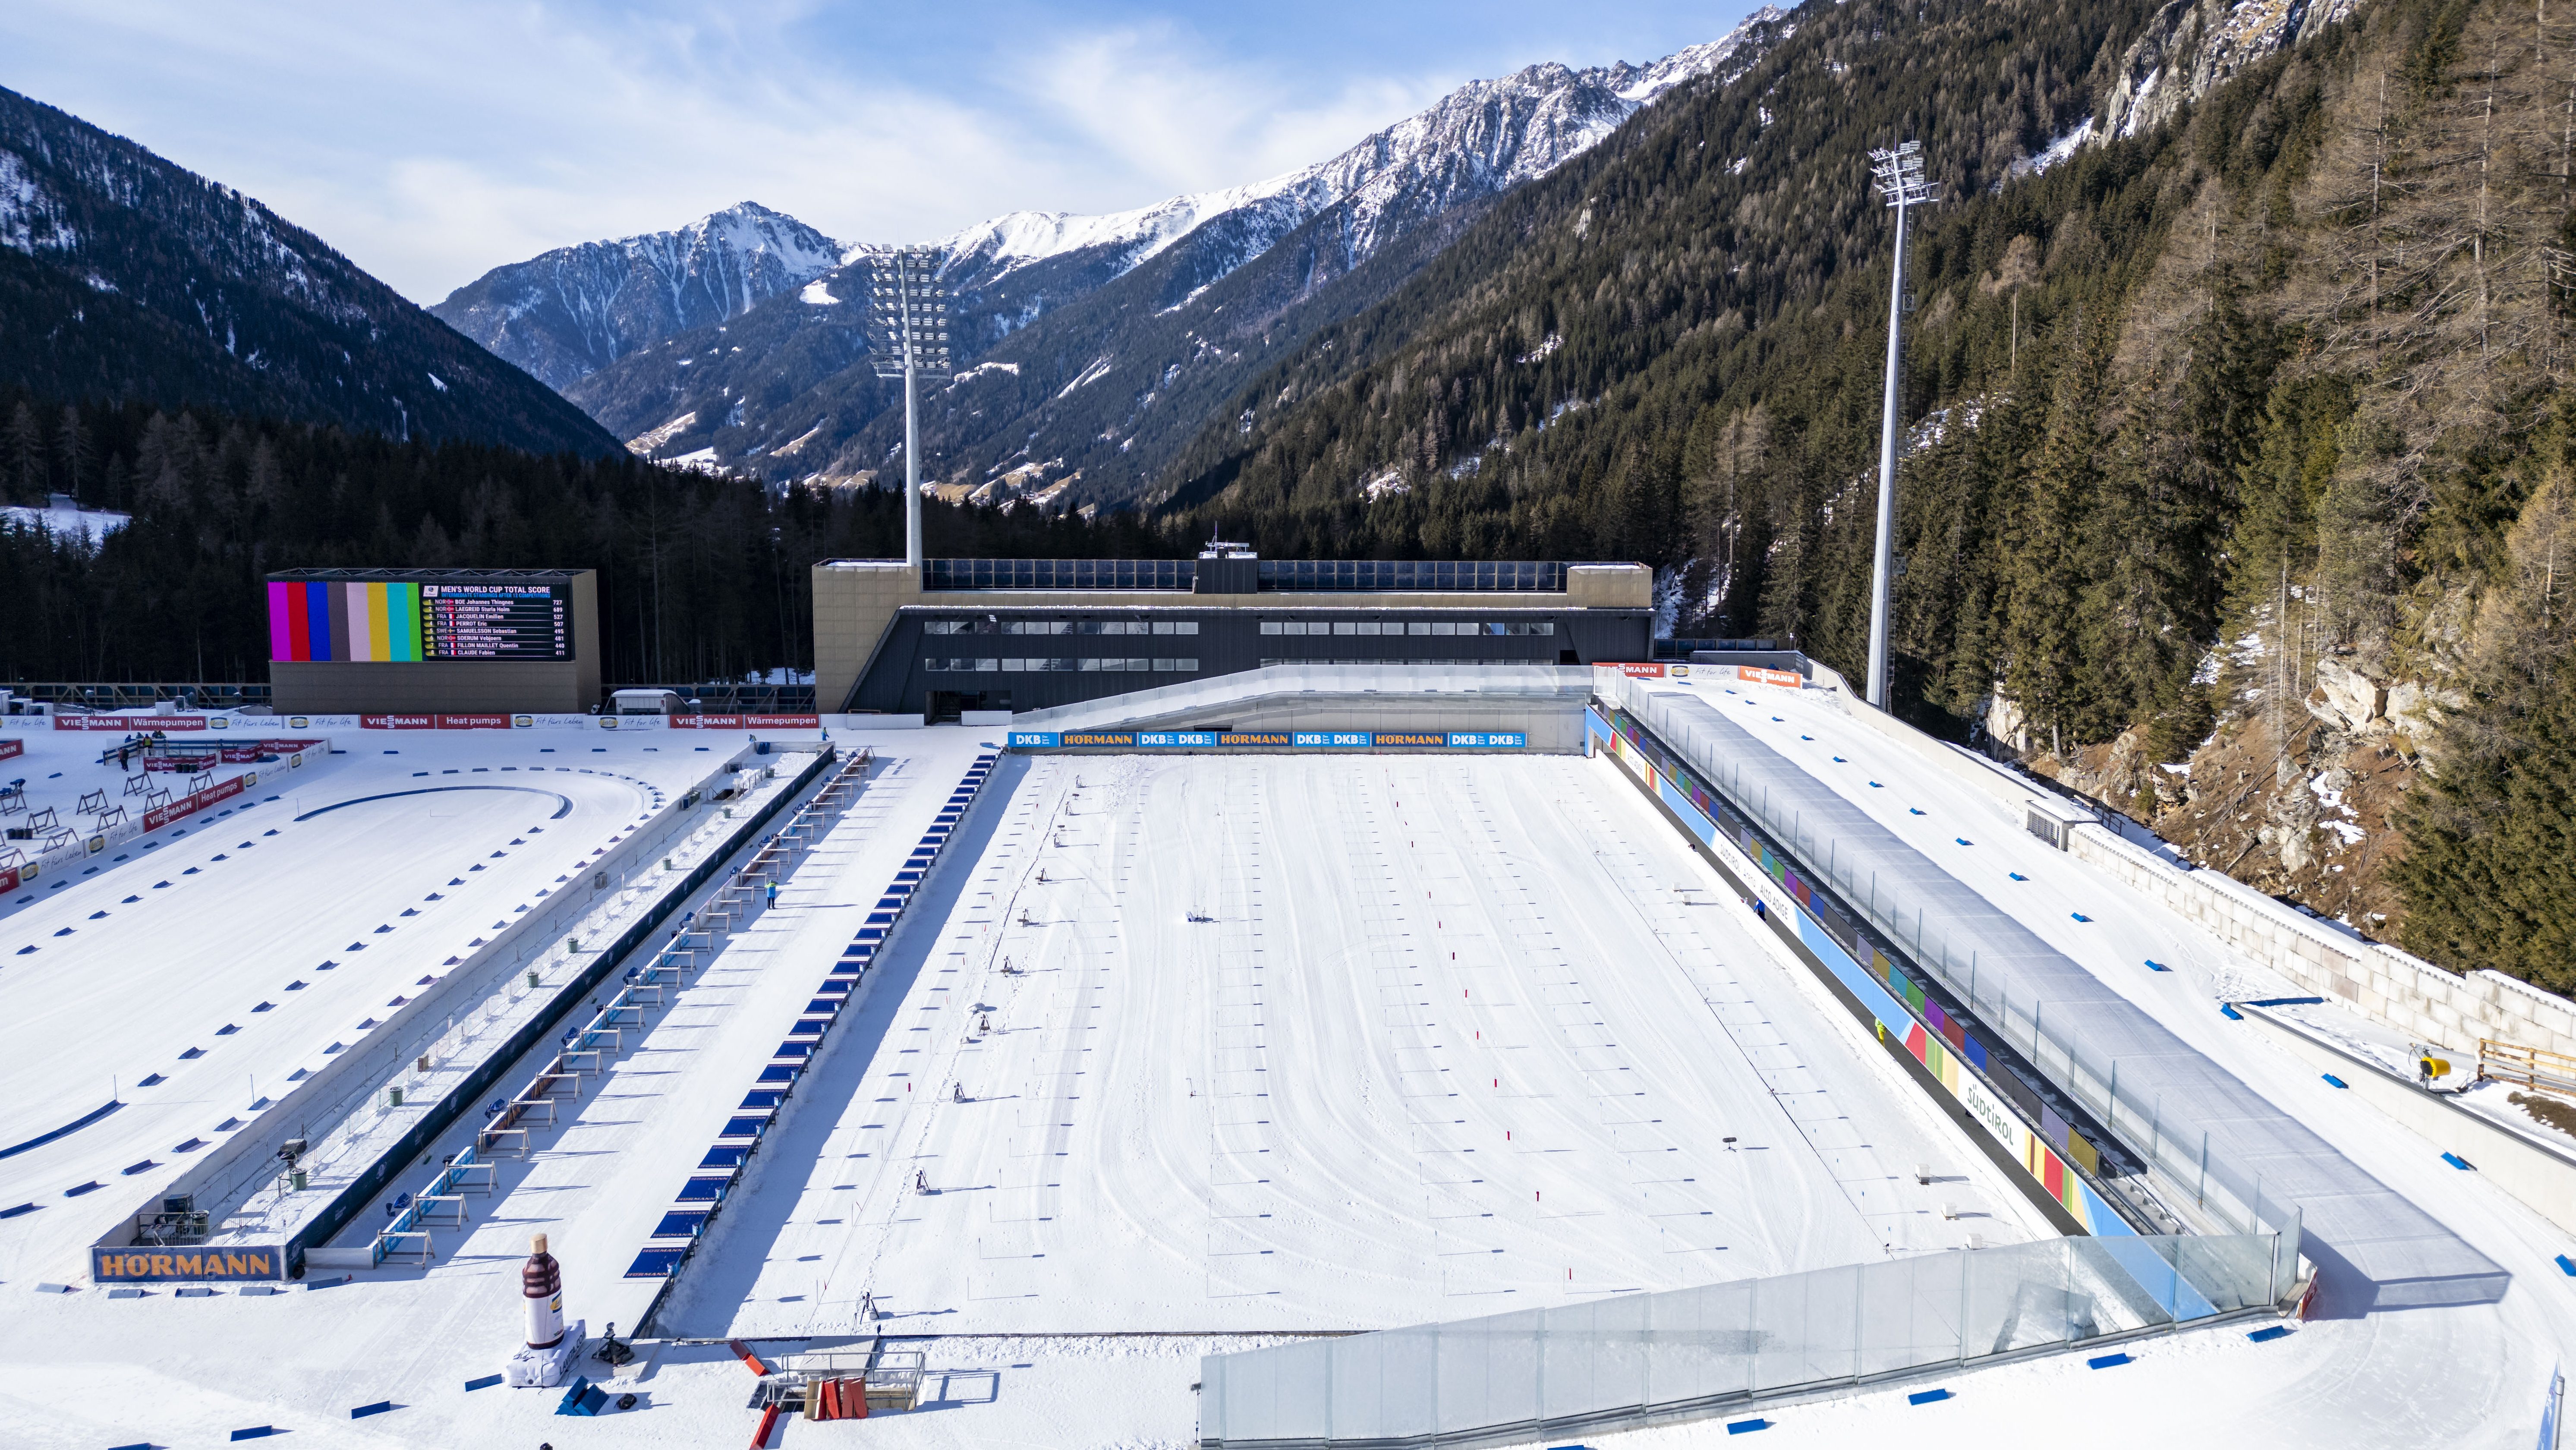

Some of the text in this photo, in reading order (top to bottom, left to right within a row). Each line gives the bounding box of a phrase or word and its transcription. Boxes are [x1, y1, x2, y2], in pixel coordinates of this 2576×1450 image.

[1707, 668, 1716, 676] for
[1745, 669, 1795, 683] VIESSMANN
[22, 719, 31, 728] for
[62, 717, 203, 730] VIESSMANN Wärmepumpen
[243, 720, 257, 728] fürs
[367, 716, 427, 728] VIESSMANN
[677, 716, 816, 729] VIESSMANN Wärmepumpen
[1016, 735, 1041, 744] DKB
[1142, 735, 1166, 744] DKB
[1179, 735, 1203, 744] DKB
[1297, 735, 1321, 744] DKB
[1334, 735, 1358, 744] DKB
[1452, 735, 1477, 744] DKB
[1490, 735, 1514, 744] DKB
[147, 761, 174, 769] VIESSMA
[199, 759, 215, 769] SSMANN
[148, 782, 237, 824] VIESSMANN Heat pumps
[110, 832, 118, 841] Fit
[41, 859, 50, 870] Fit
[51, 856, 63, 870] fürs
[66, 846, 82, 860] Leben
[102, 1253, 270, 1276] HÖRMANN
